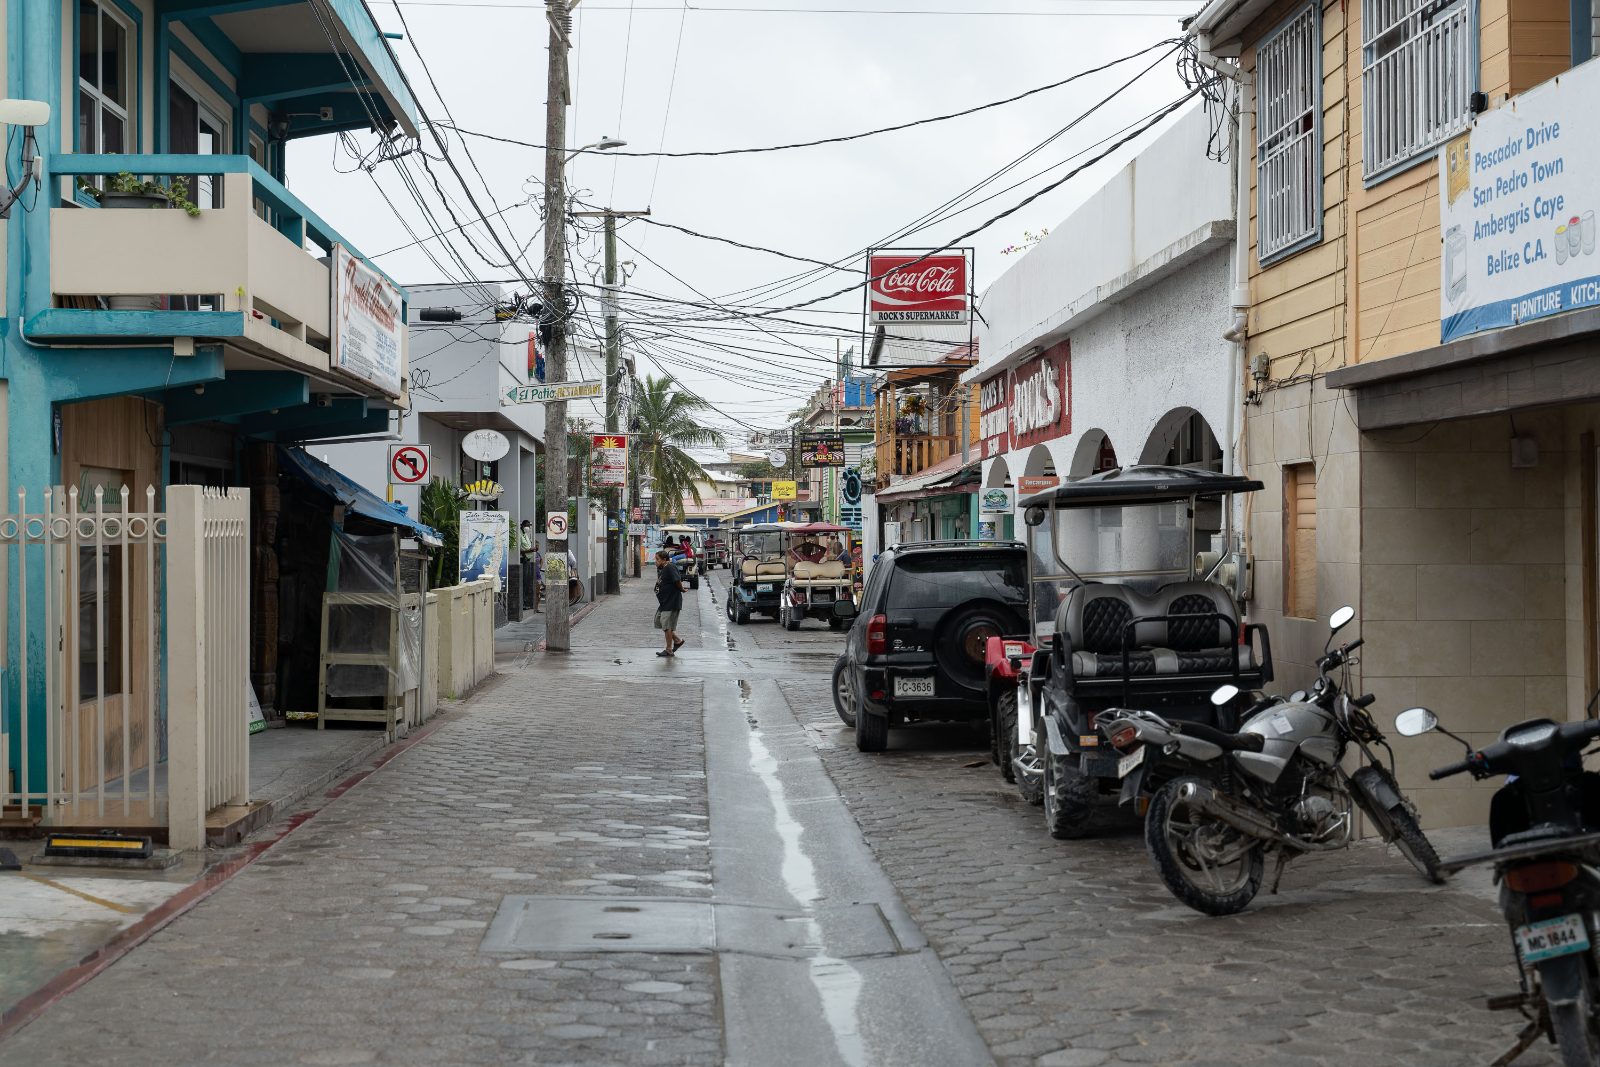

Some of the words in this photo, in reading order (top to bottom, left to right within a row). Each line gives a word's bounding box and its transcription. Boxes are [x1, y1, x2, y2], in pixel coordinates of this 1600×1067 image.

[1474, 136, 1522, 173] Pescador
[1526, 121, 1560, 150] Drive
[1473, 186, 1492, 208] San
[1496, 171, 1528, 197] Pedro
[1531, 157, 1564, 184] Town
[1473, 202, 1530, 242] Ambergris
[1533, 194, 1564, 220] Caye
[1487, 251, 1520, 276] Belize
[1523, 238, 1548, 265] C.A.
[878, 312, 904, 320] ROCK'S
[905, 311, 960, 320] SUPERMARKET
[1511, 290, 1562, 321] FURNITURE
[519, 390, 528, 400] El
[902, 682, 932, 692] C-3636
[1527, 934, 1547, 952] MC
